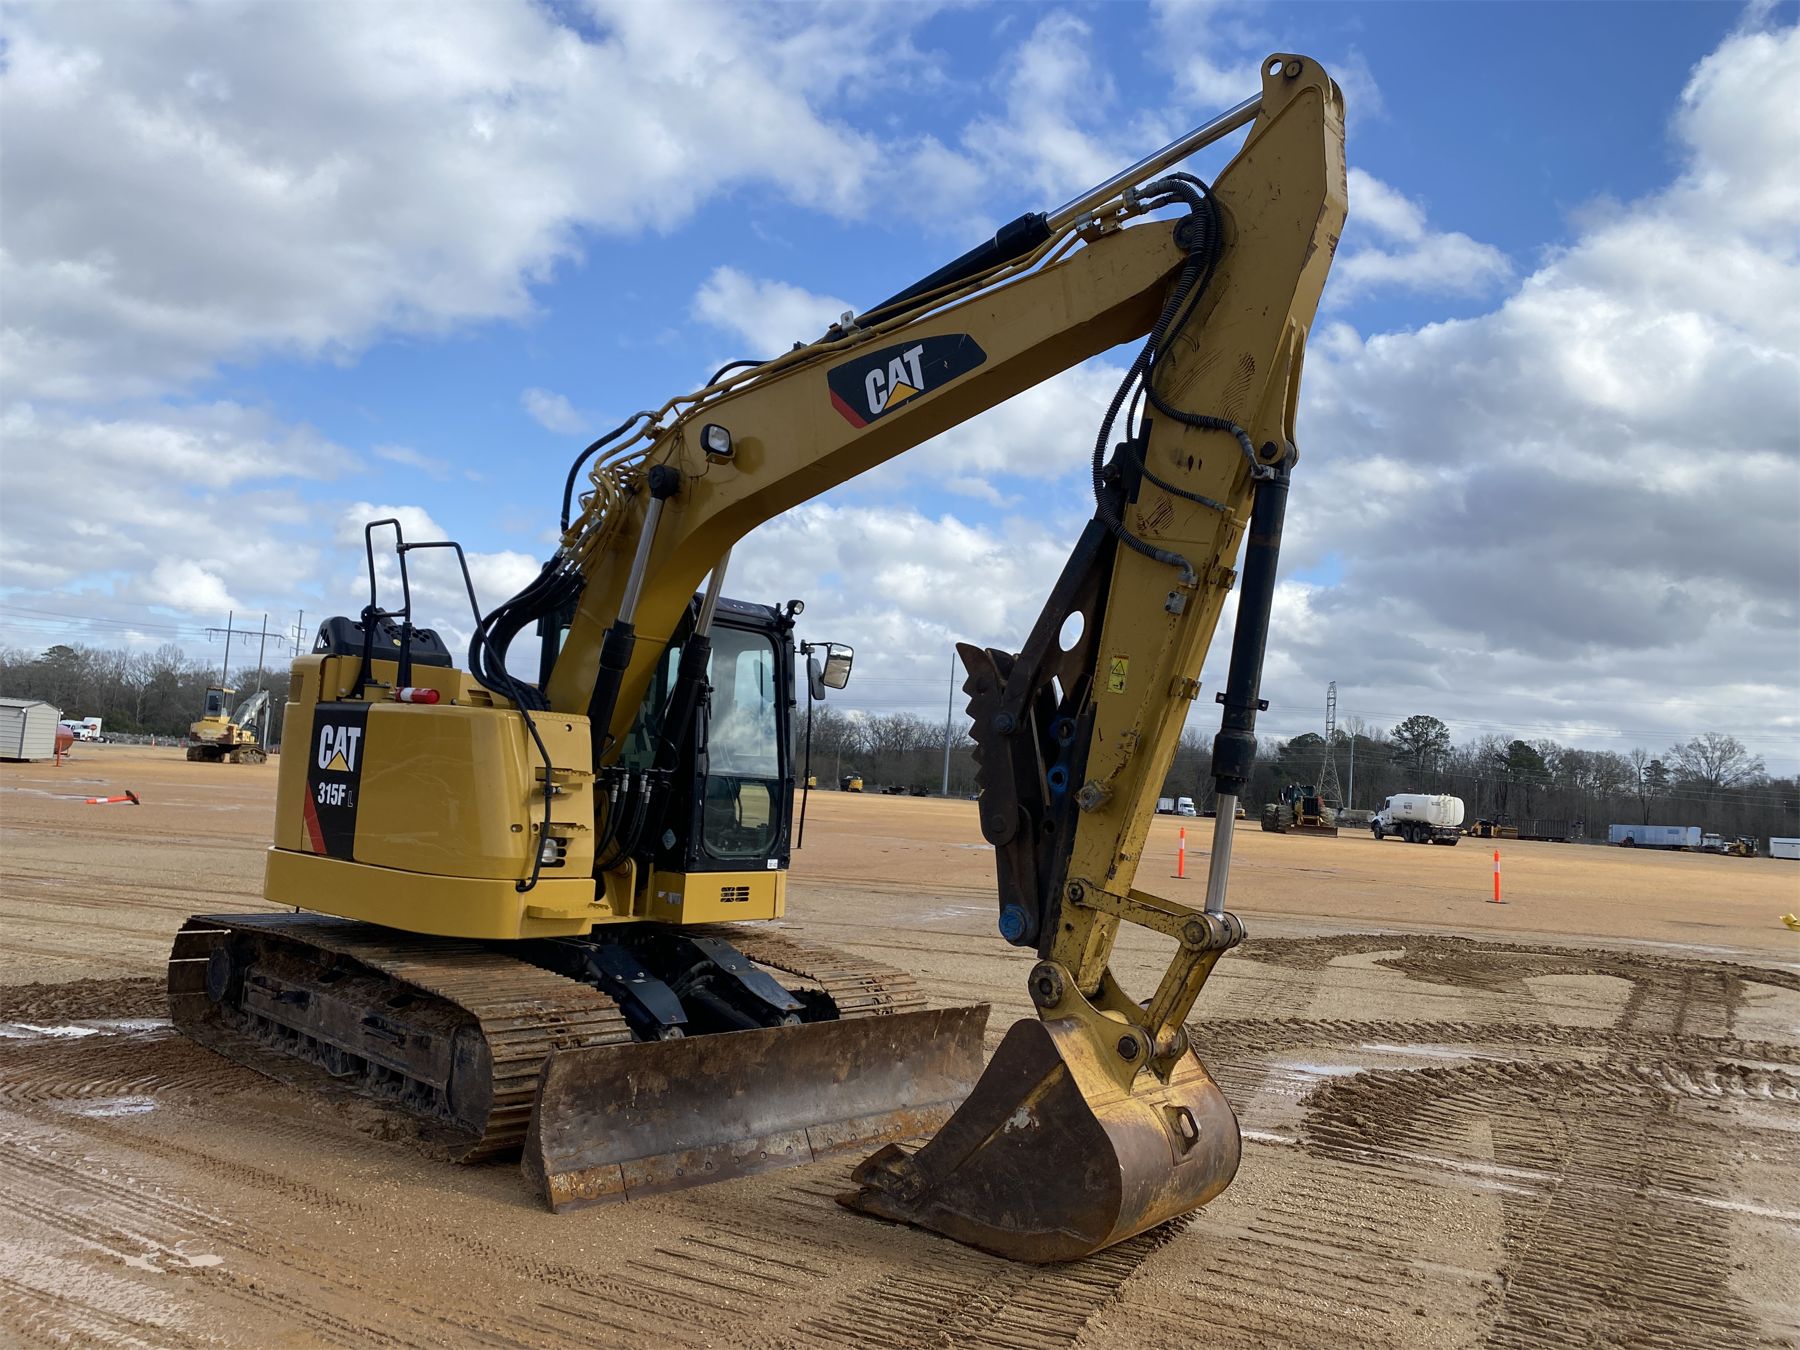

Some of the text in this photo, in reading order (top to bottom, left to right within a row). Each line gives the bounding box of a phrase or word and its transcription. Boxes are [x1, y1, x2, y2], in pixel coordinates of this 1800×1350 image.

[864, 344, 925, 415] CAT
[317, 724, 361, 772] CAT
[317, 781, 354, 808] 315F L
